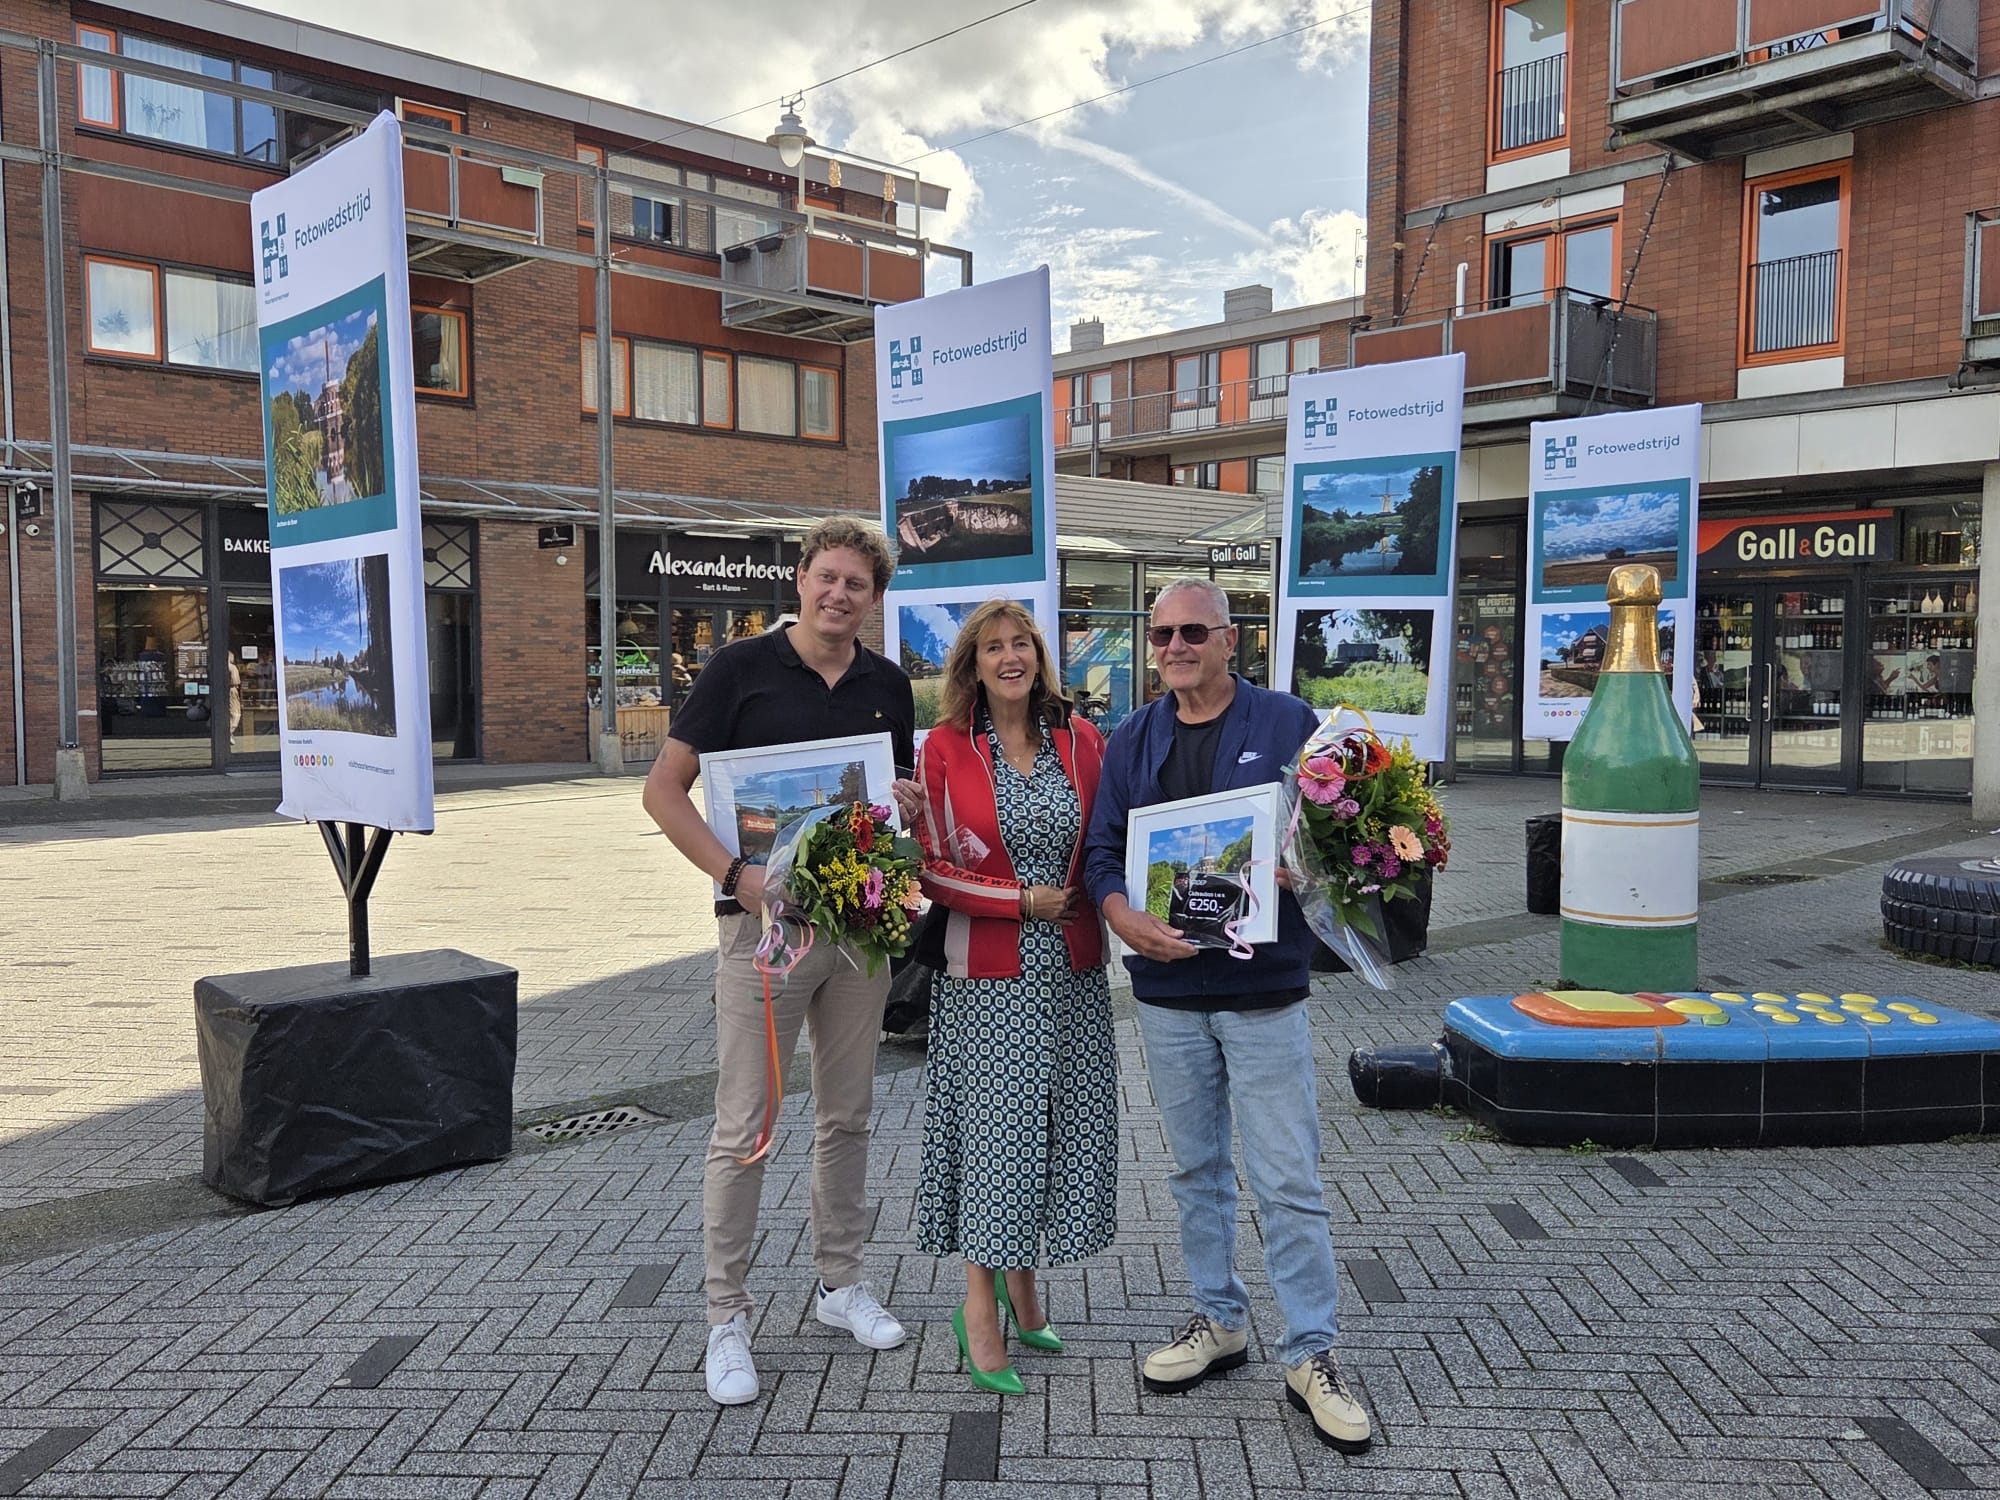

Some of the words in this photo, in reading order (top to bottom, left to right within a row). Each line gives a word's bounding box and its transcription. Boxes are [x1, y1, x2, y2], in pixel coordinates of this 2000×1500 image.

[294, 187, 372, 250] Fotowedstrijd
[932, 327, 1027, 365] Fotowedstrijd
[1348, 399, 1444, 422] Fotowedstrijd
[1587, 434, 1681, 456] Fotowedstrijd
[1211, 548, 1231, 562] Gall
[1236, 546, 1256, 560] Gall
[1737, 528, 1796, 561] Gall
[1814, 523, 1876, 558] Gall
[648, 550, 795, 581] Alexanderhoeve
[1188, 898, 1224, 914] €250,-
